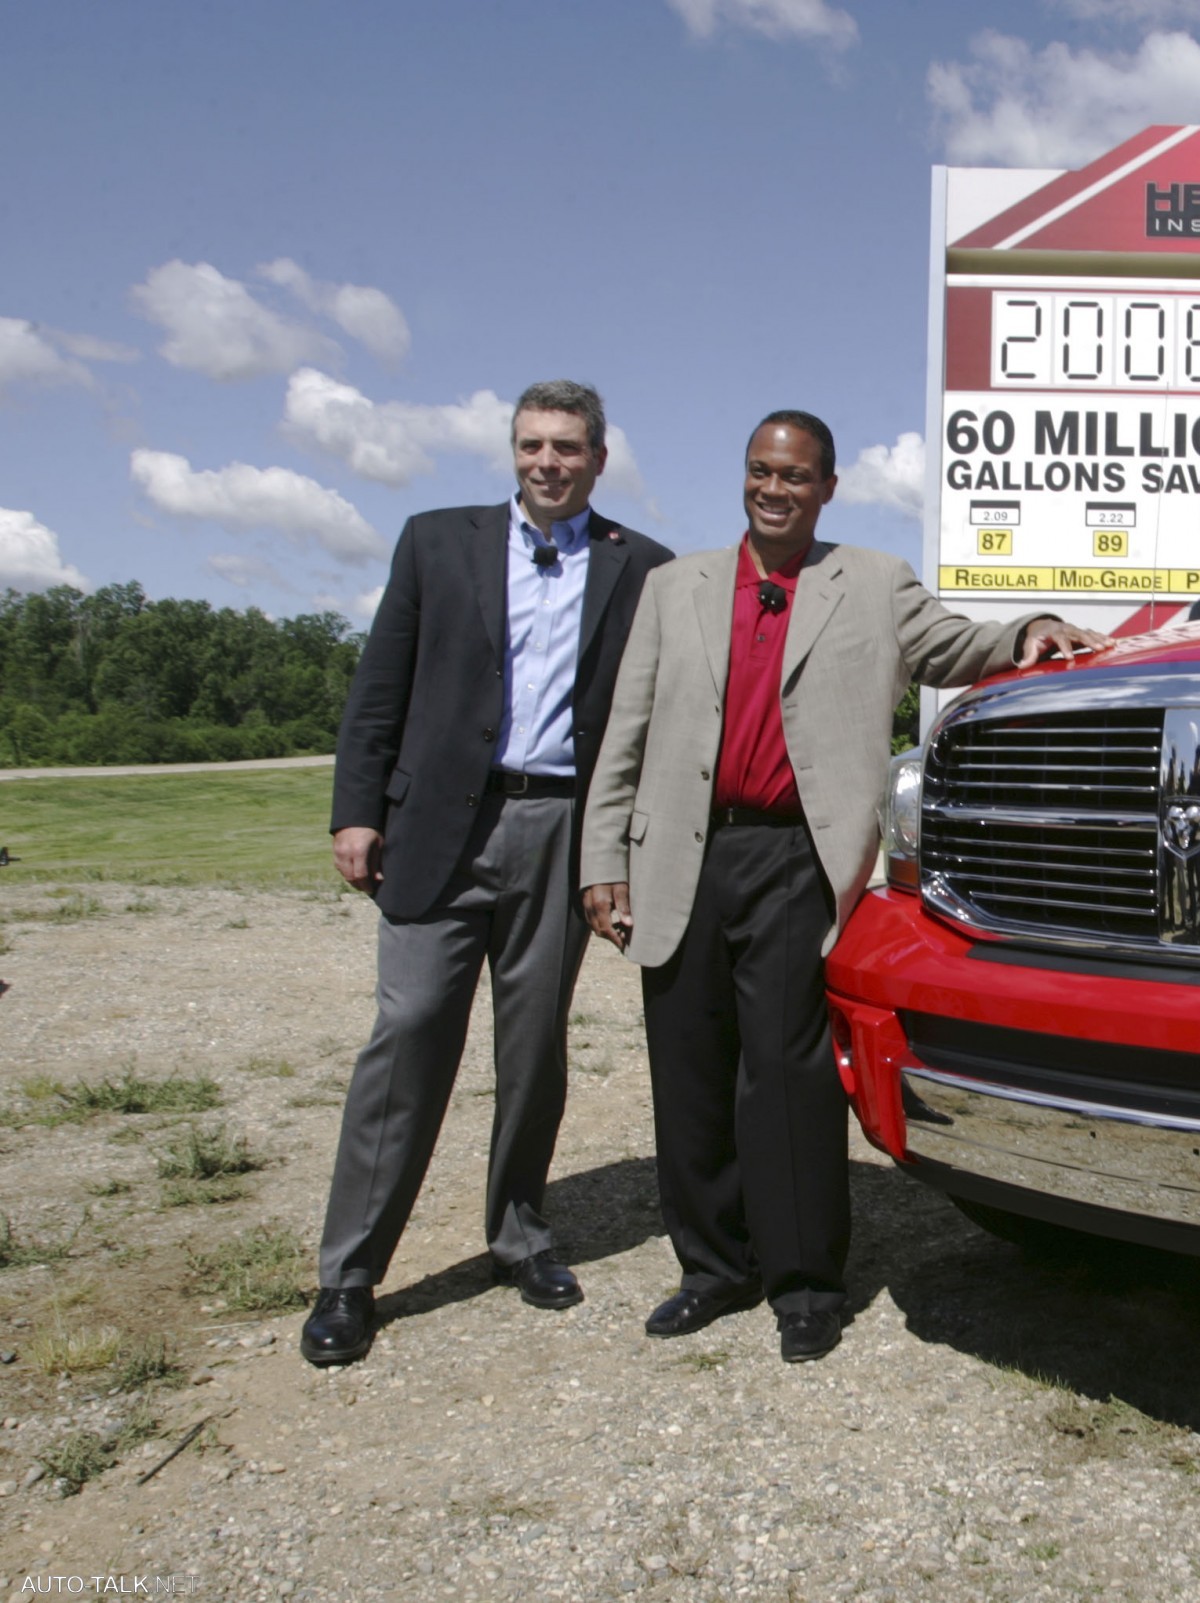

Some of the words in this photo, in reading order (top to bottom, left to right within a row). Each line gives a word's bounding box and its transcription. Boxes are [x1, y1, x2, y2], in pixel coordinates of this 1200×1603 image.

[946, 410, 1015, 455] 60
[946, 460, 1126, 492] GALLONS
[983, 511, 1008, 523] 2.09
[1099, 513, 1124, 525] 2.22
[982, 533, 1007, 551] 87
[1097, 535, 1123, 552] 89
